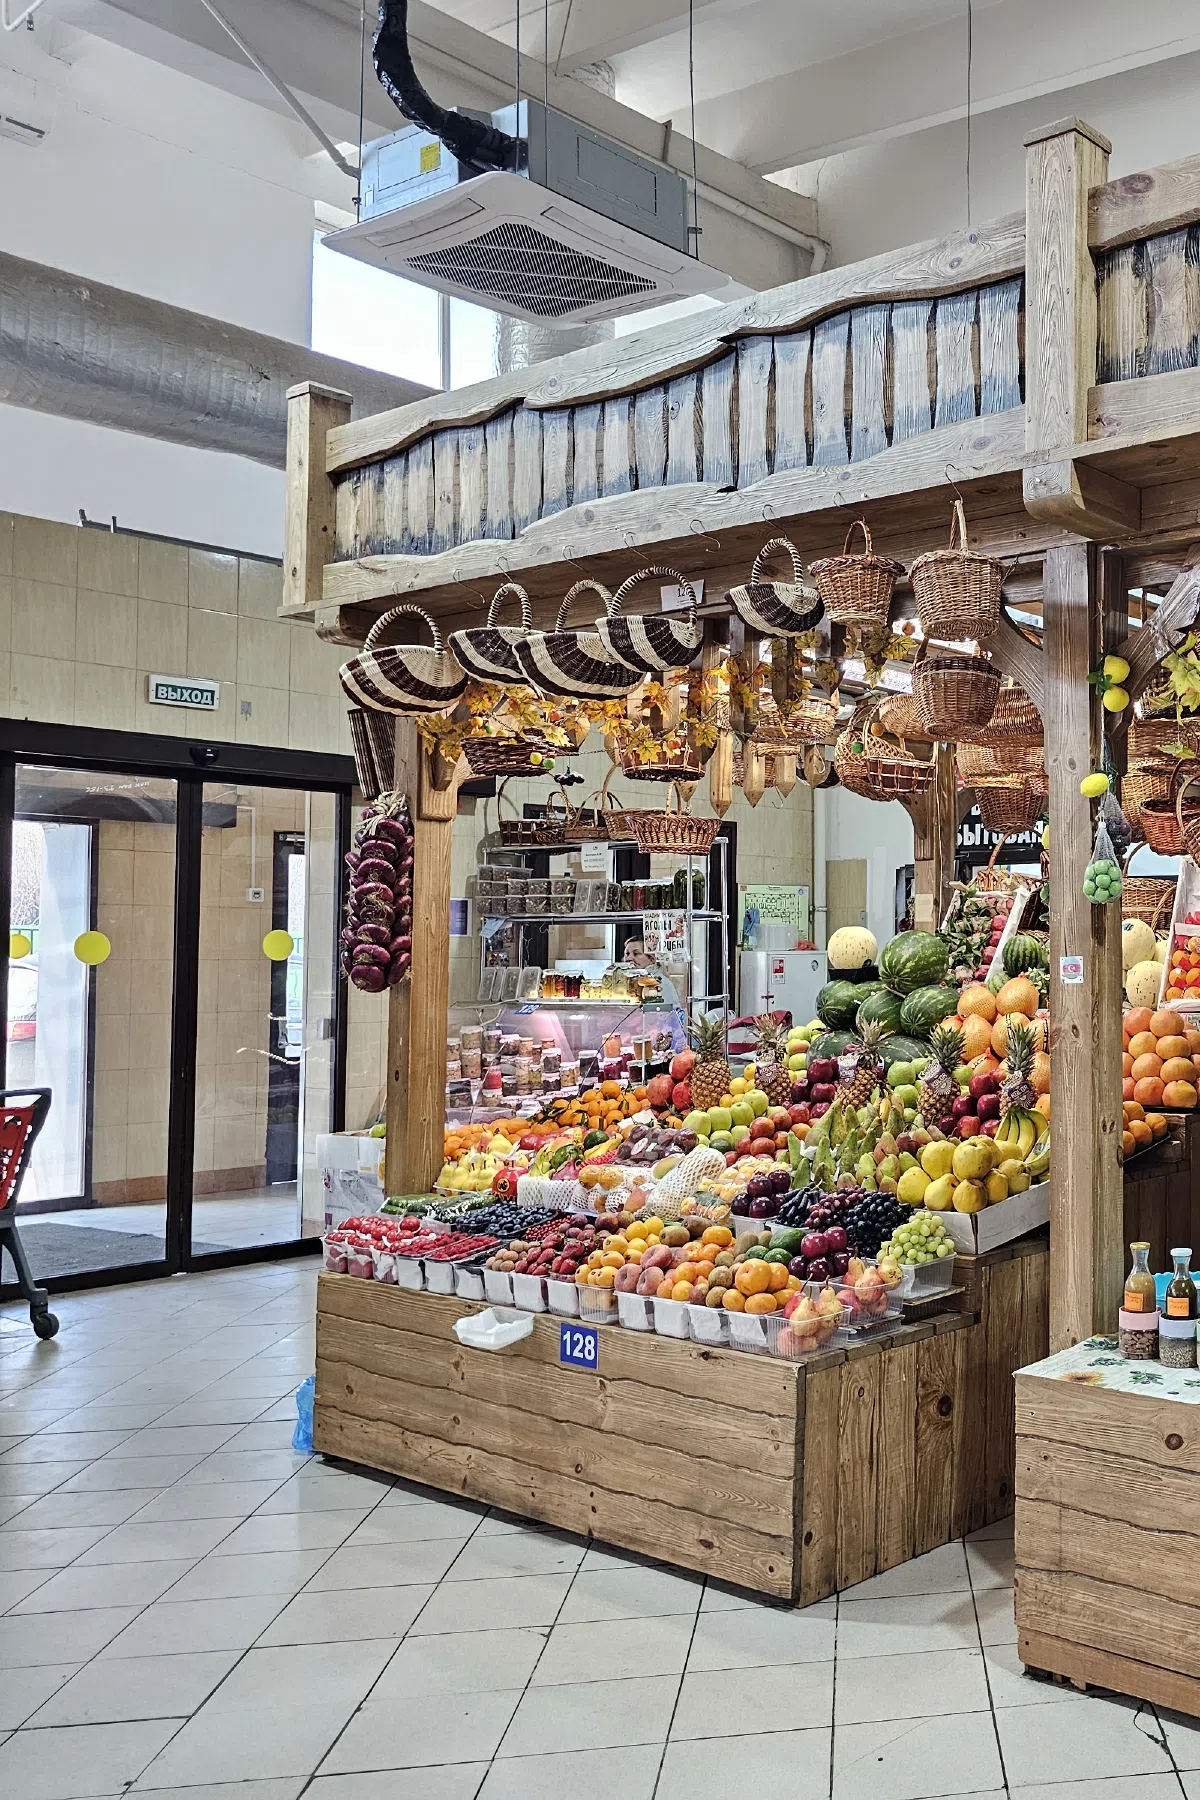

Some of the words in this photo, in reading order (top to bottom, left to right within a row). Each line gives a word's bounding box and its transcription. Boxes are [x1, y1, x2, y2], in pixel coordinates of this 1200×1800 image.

[677, 587, 690, 598] 12
[157, 686, 214, 706] ВЫХОД
[562, 1330, 595, 1361] 128
